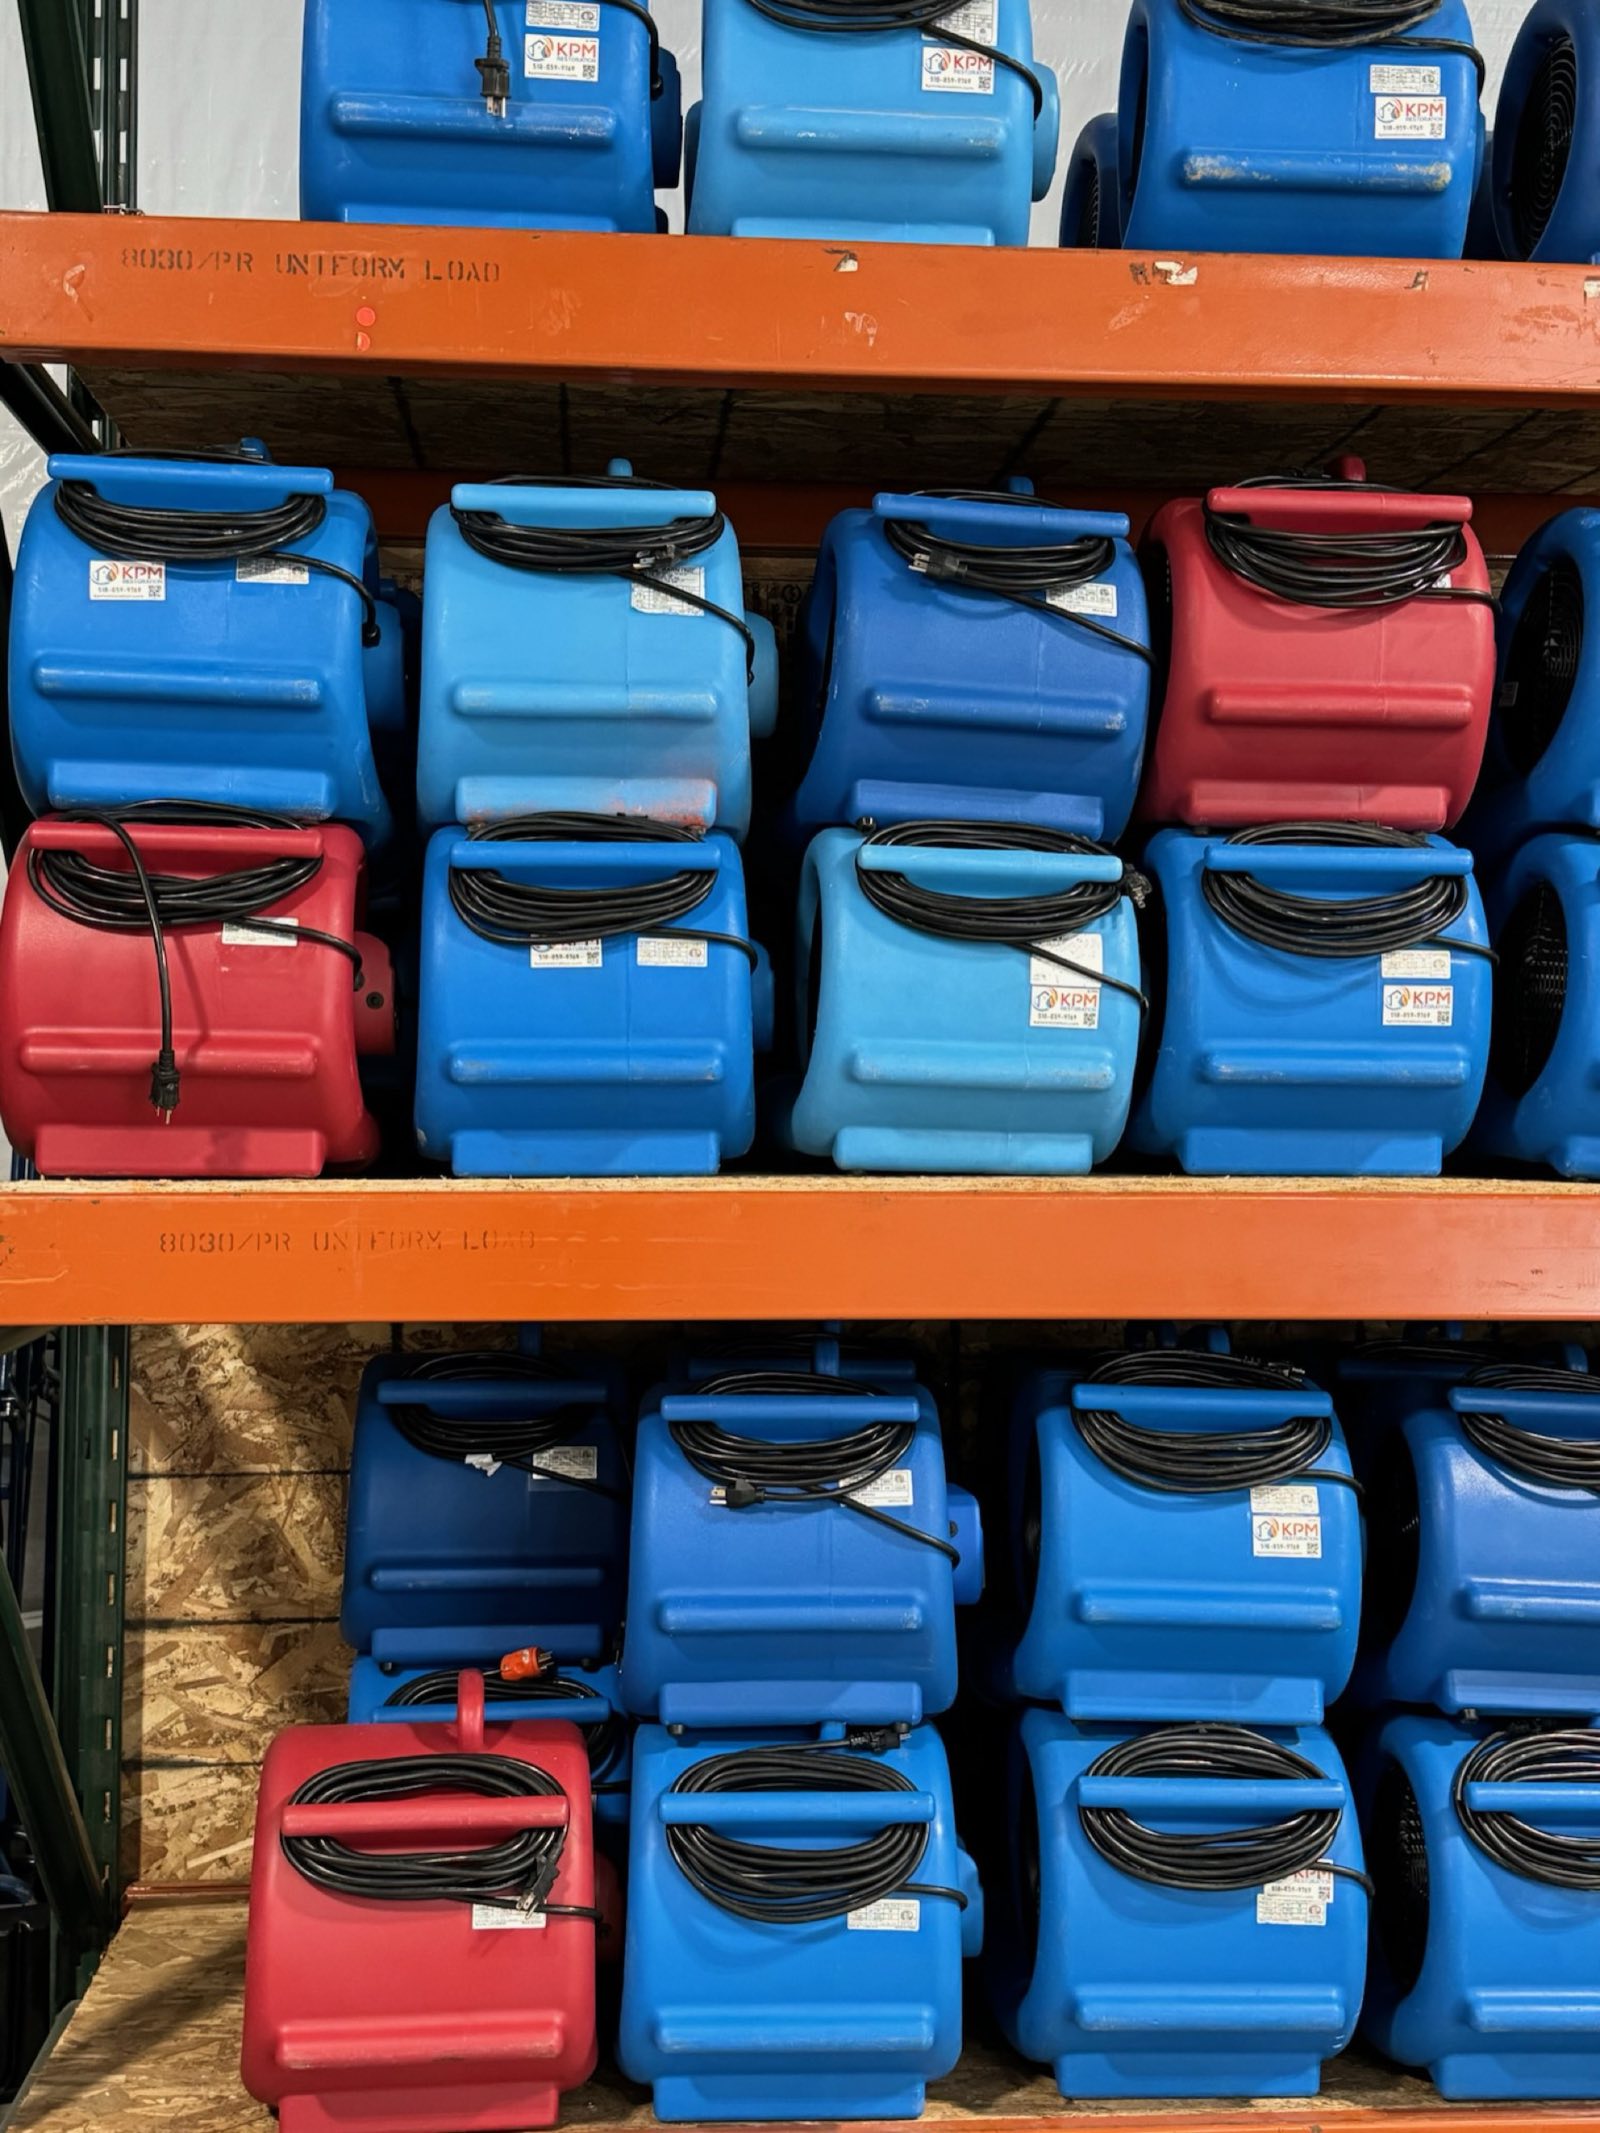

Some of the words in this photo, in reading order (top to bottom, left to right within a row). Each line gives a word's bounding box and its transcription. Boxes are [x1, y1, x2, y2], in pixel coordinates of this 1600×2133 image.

[557, 42, 597, 58] KPM
[953, 55, 993, 71] KPM
[1405, 103, 1444, 116] KPM
[121, 248, 253, 273] 8030/PR
[275, 252, 405, 280] UNIFORM
[425, 259, 500, 282] LOAD
[122, 566, 163, 579] KPM
[1061, 993, 1098, 1007] KPM
[1413, 991, 1451, 1004] KPM
[159, 1232, 290, 1253] 8030/PR
[313, 1231, 442, 1251] UNIFORM
[1282, 1522, 1319, 1536] KPM
